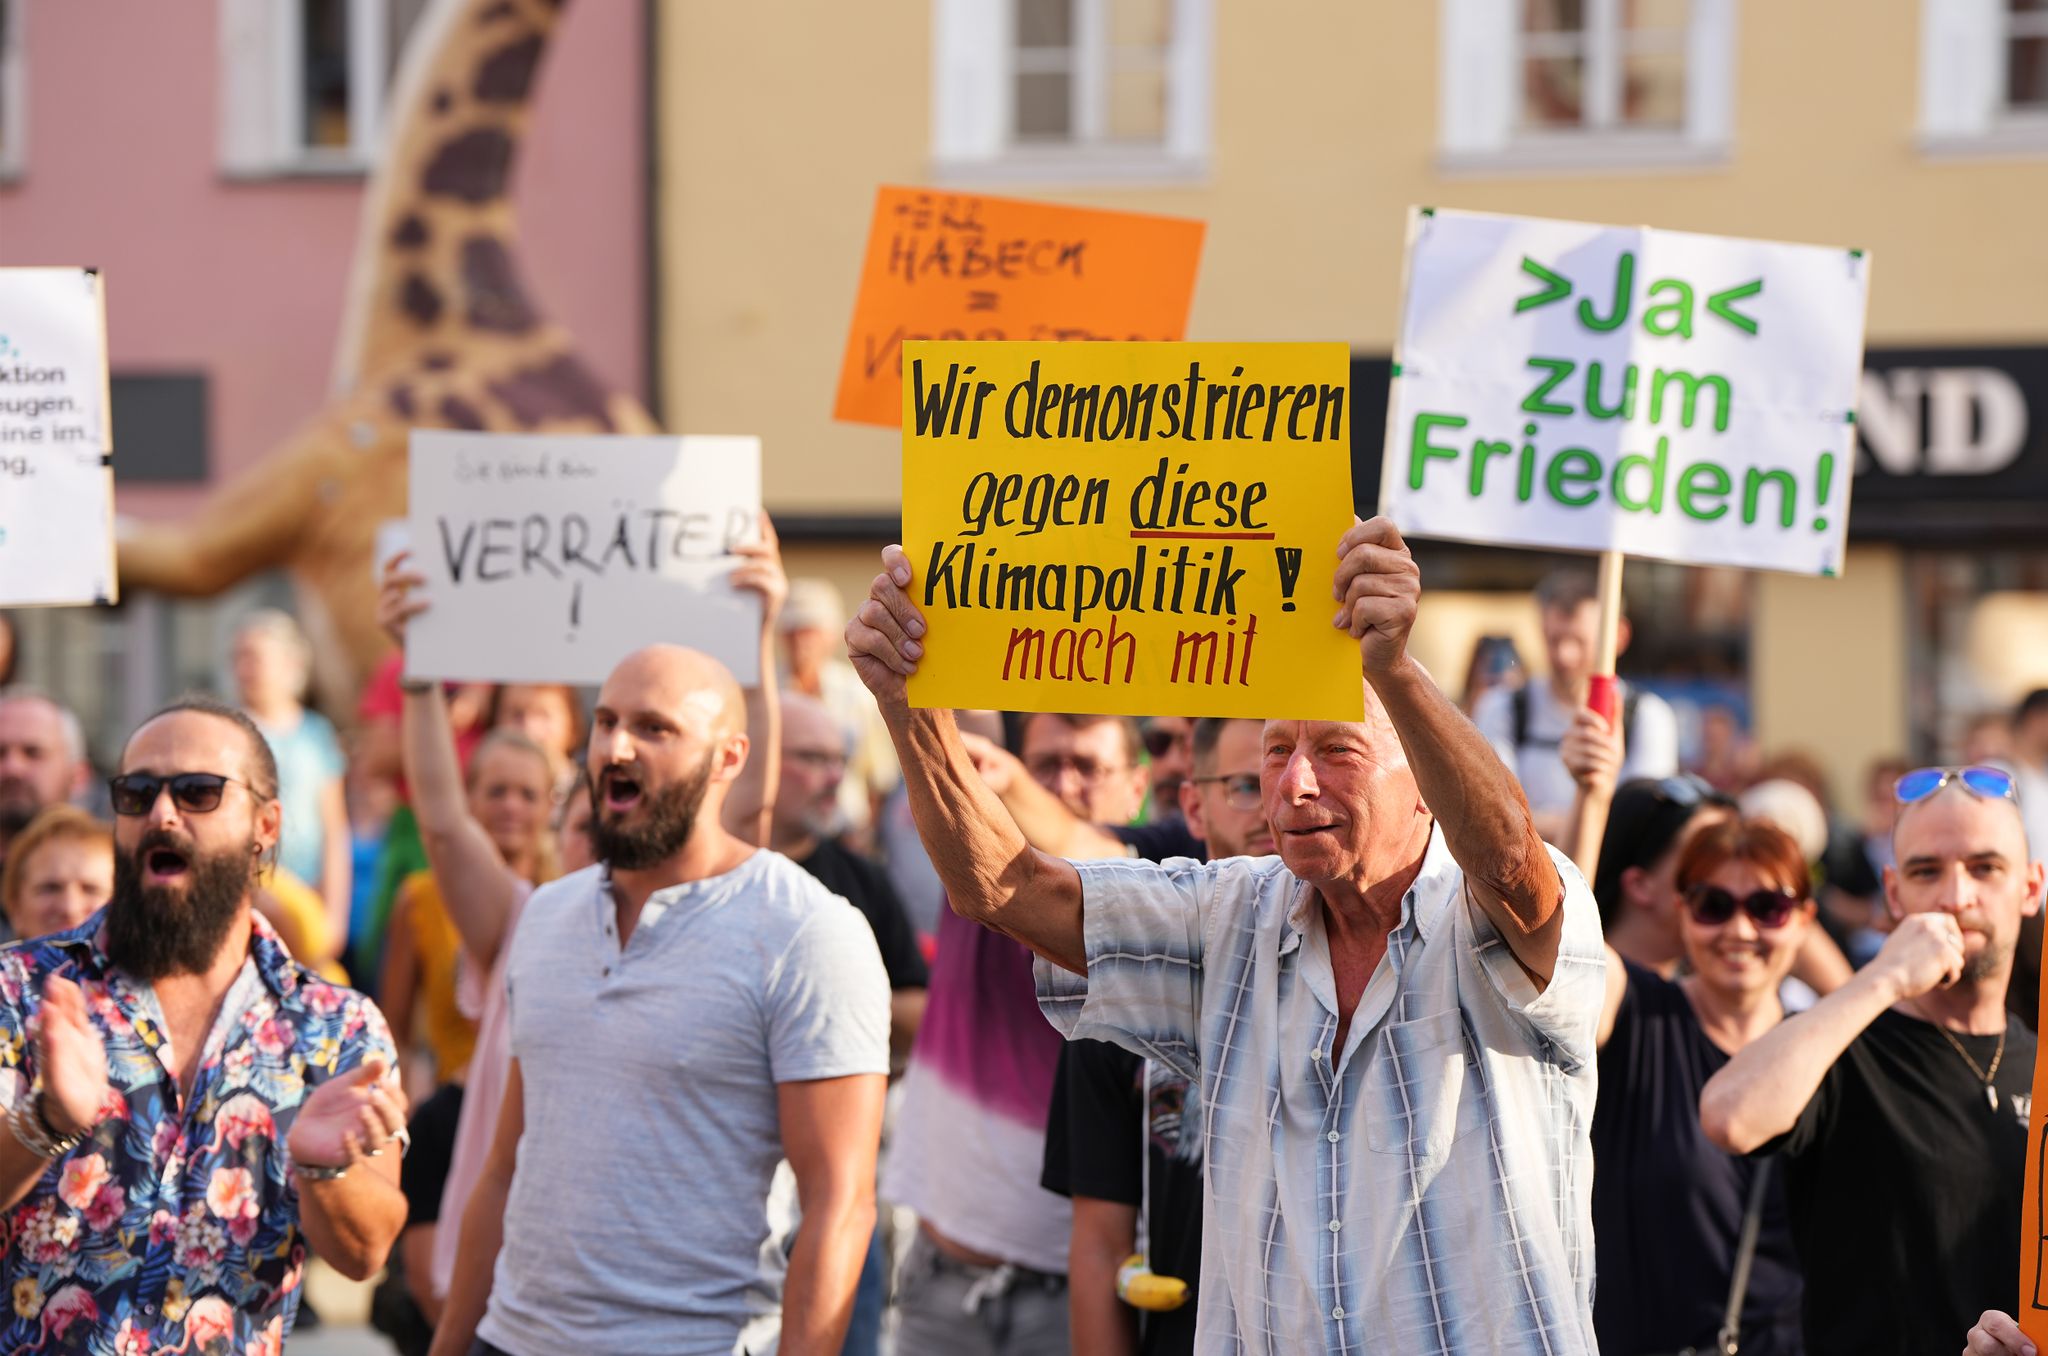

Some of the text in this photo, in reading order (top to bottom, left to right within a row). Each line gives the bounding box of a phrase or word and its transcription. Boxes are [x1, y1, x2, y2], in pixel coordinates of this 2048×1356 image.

[912, 358, 1345, 442] Wir demonstrieren
[1520, 357, 1732, 433] zum
[957, 456, 1268, 537] gegen diese
[1407, 412, 1835, 532] Frieden!
[565, 580, 583, 643] !
[924, 541, 1302, 623] Klimapolitik !
[1002, 614, 1258, 687] mach mit
